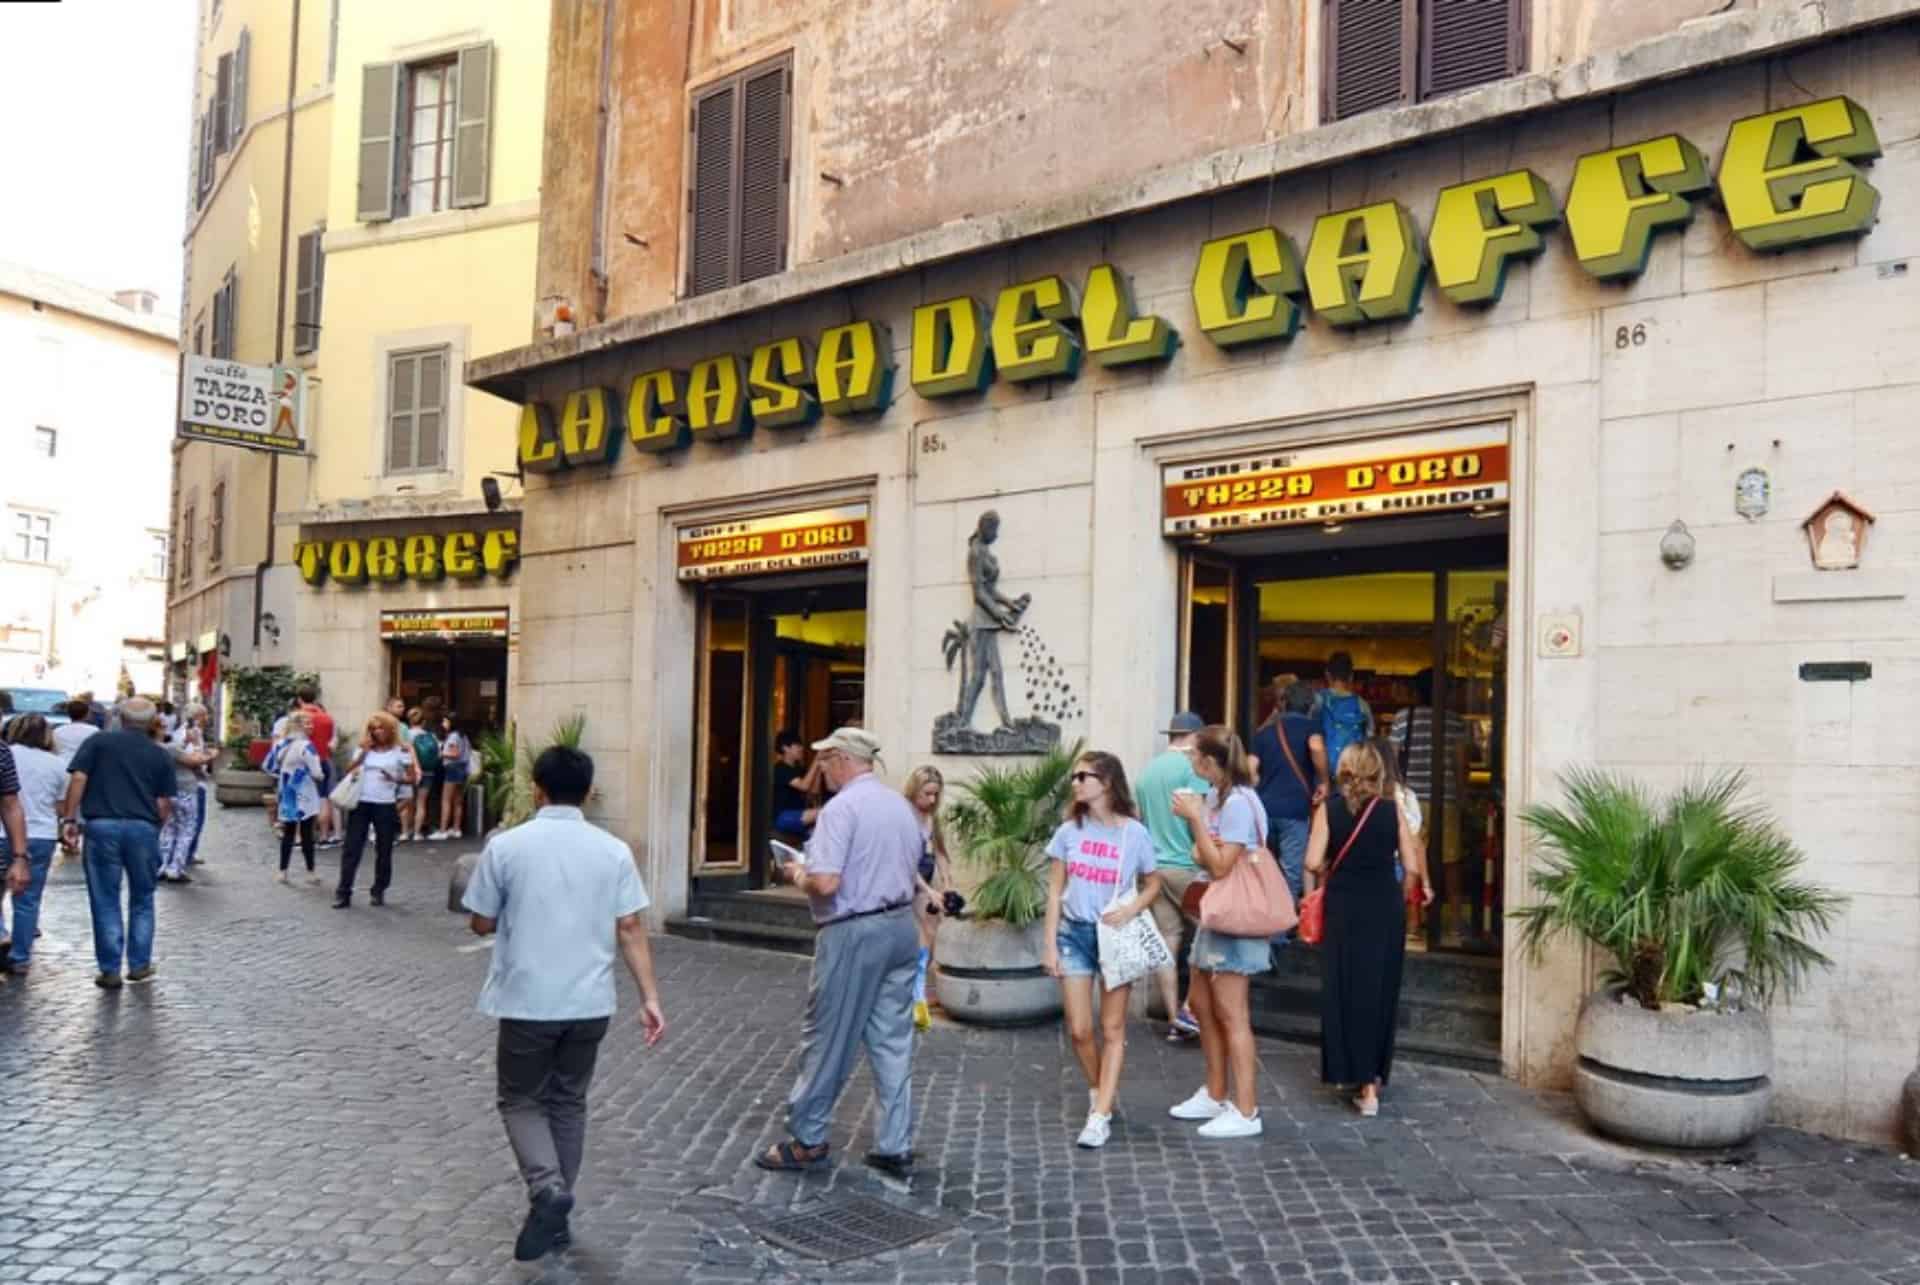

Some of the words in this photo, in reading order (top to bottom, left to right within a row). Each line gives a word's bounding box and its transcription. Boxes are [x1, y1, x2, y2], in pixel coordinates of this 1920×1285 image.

[1615, 322, 1647, 349] 86
[520, 386, 618, 472] LA
[627, 320, 893, 452] CASA
[911, 264, 1178, 398] DEL
[194, 376, 267, 405] TAZZA
[193, 399, 267, 426] D'ORO
[1183, 474, 1313, 508] TAZZA
[1347, 454, 1481, 489] D'ORO
[1174, 520, 1197, 531] EL
[1210, 507, 1307, 527] MEJOR
[1318, 501, 1372, 517] DEL
[1382, 487, 1495, 510] MUNDO
[295, 530, 520, 585] TORREF
[690, 536, 763, 559] TAZZA
[781, 525, 853, 549] D'ORO
[1080, 839, 1120, 859] GIRL
